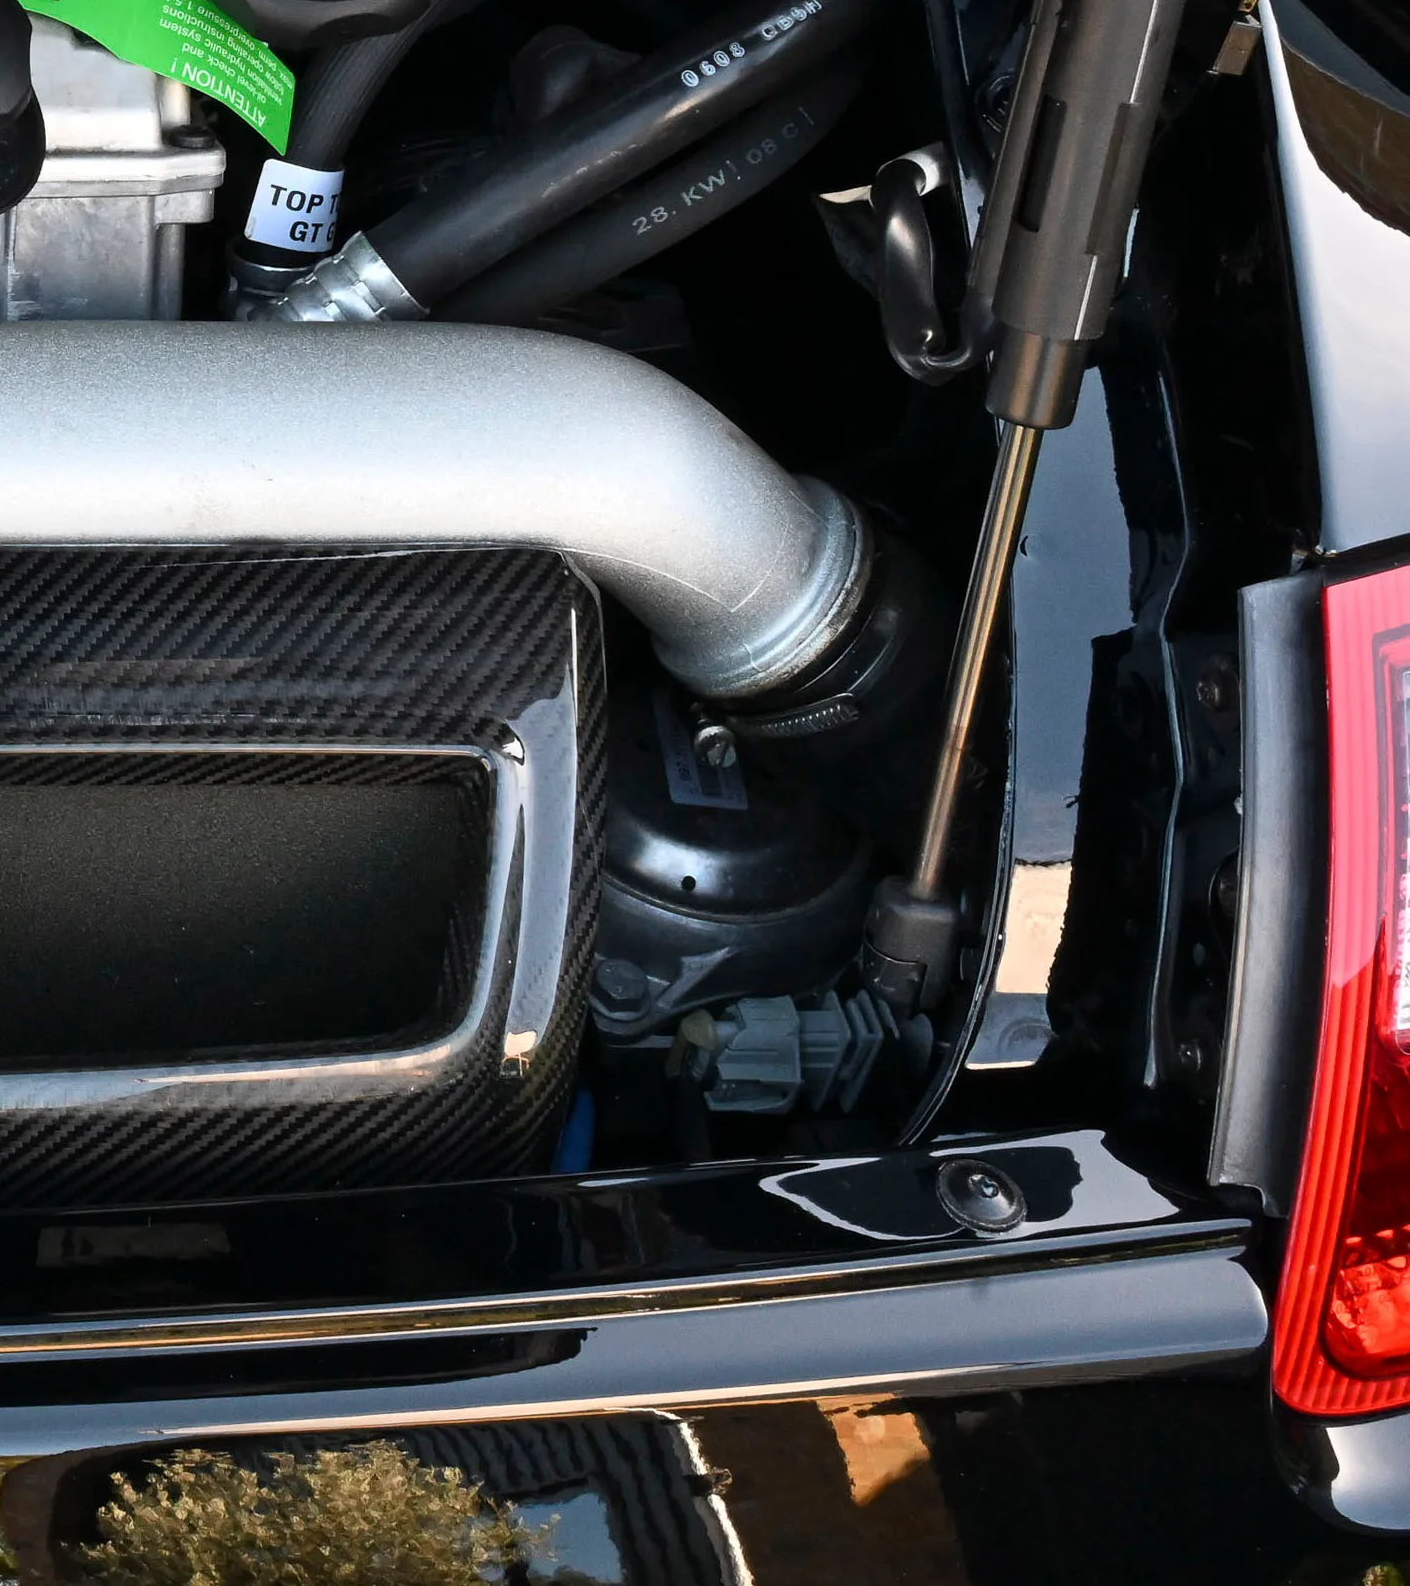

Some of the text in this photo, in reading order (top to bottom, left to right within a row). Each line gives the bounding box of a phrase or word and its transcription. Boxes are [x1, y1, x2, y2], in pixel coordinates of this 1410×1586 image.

[159, 17, 202, 43] system
[162, 4, 225, 42] instructions
[197, 5, 255, 51] overpressure
[182, 42, 205, 58] and
[203, 38, 246, 74] hydraulic
[206, 54, 236, 77] check
[227, 36, 264, 73] operating
[681, 41, 746, 88] 0608
[181, 61, 268, 128] ATTENTION
[270, 183, 324, 214] TOP
[289, 220, 324, 243] GT
